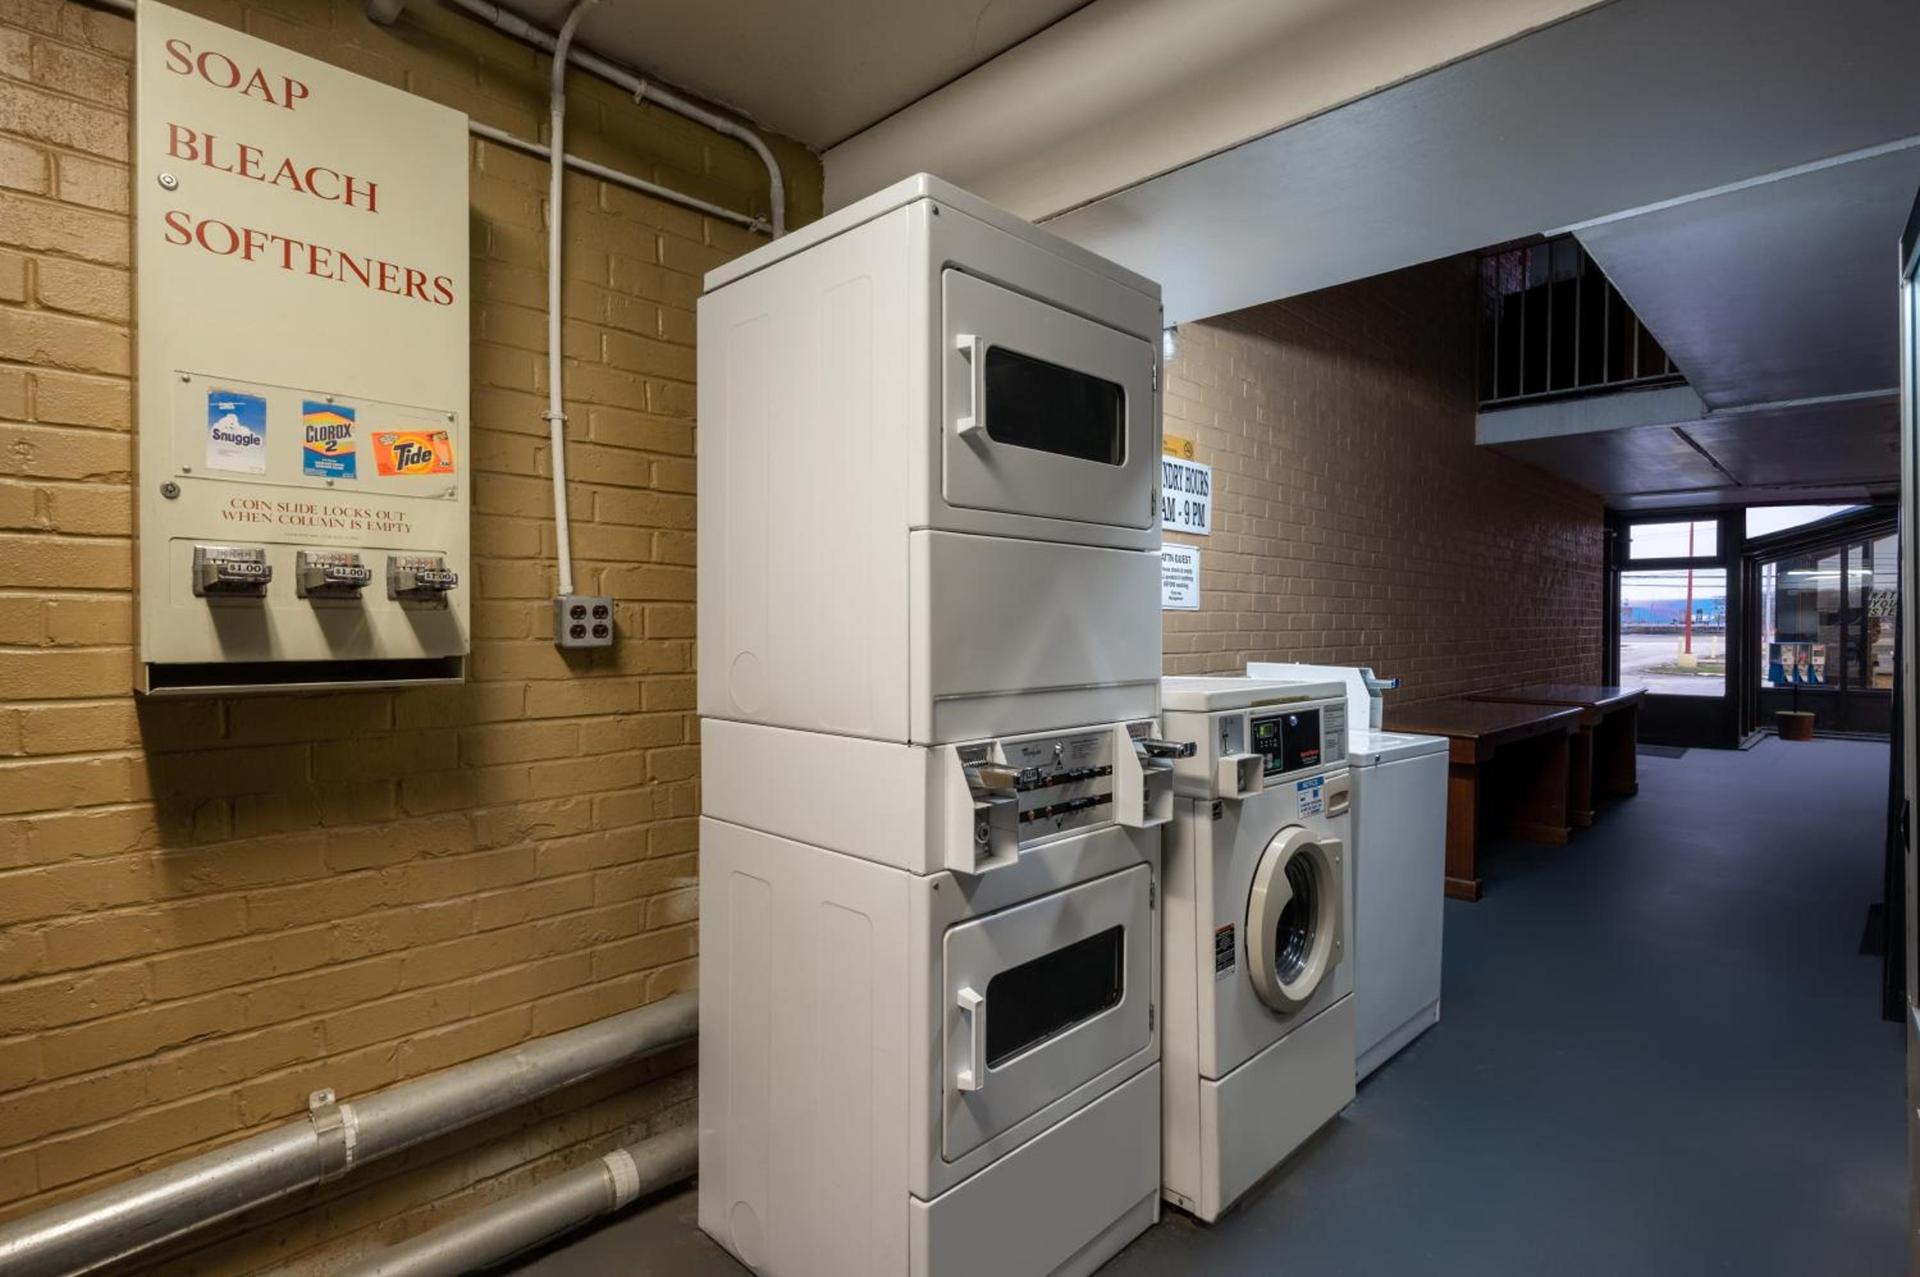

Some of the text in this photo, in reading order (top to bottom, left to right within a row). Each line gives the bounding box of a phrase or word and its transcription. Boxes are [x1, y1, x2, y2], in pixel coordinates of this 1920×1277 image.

[165, 38, 310, 111] SOAP
[166, 122, 379, 214] BLEACH
[164, 210, 455, 306] SOFTENERS
[212, 428, 261, 447] Snuggle
[306, 423, 352, 443] CLOROX
[325, 440, 337, 452] 2
[393, 442, 432, 471] Tide
[1185, 466, 1209, 497] HOURS
[221, 510, 412, 534] WHEN COLUMN IS EMPTY
[230, 498, 406, 522] COIN SLIDE LOCKS OUT
[1184, 500, 1190, 525] 9
[1192, 501, 1206, 528] PM
[229, 563, 262, 573] $1.00
[1175, 554, 1191, 564] GUEST
[334, 568, 363, 576] $1.00
